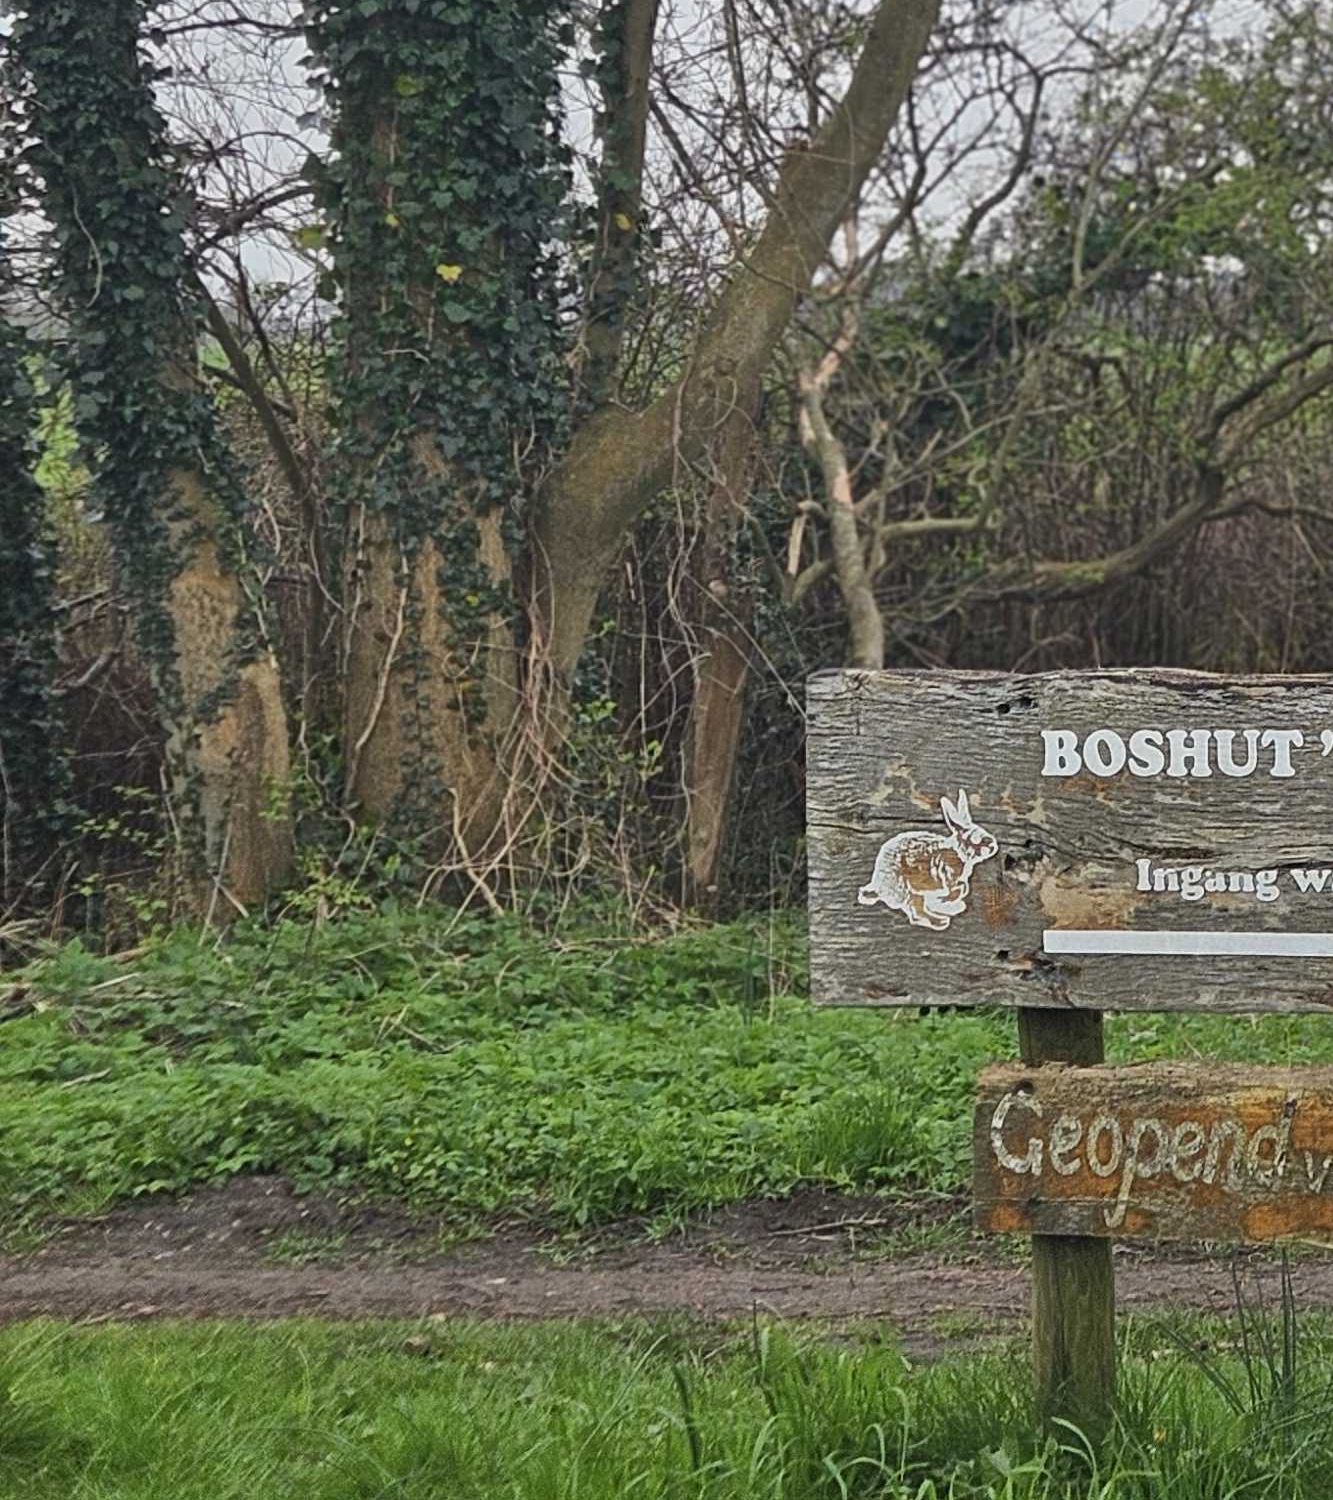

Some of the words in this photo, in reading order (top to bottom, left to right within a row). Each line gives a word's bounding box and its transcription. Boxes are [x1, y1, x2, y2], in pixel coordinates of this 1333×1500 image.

[1041, 729, 1304, 778] BOSHUT
[1135, 856, 1280, 902] Ingang
[990, 1089, 1299, 1229] Geopend
